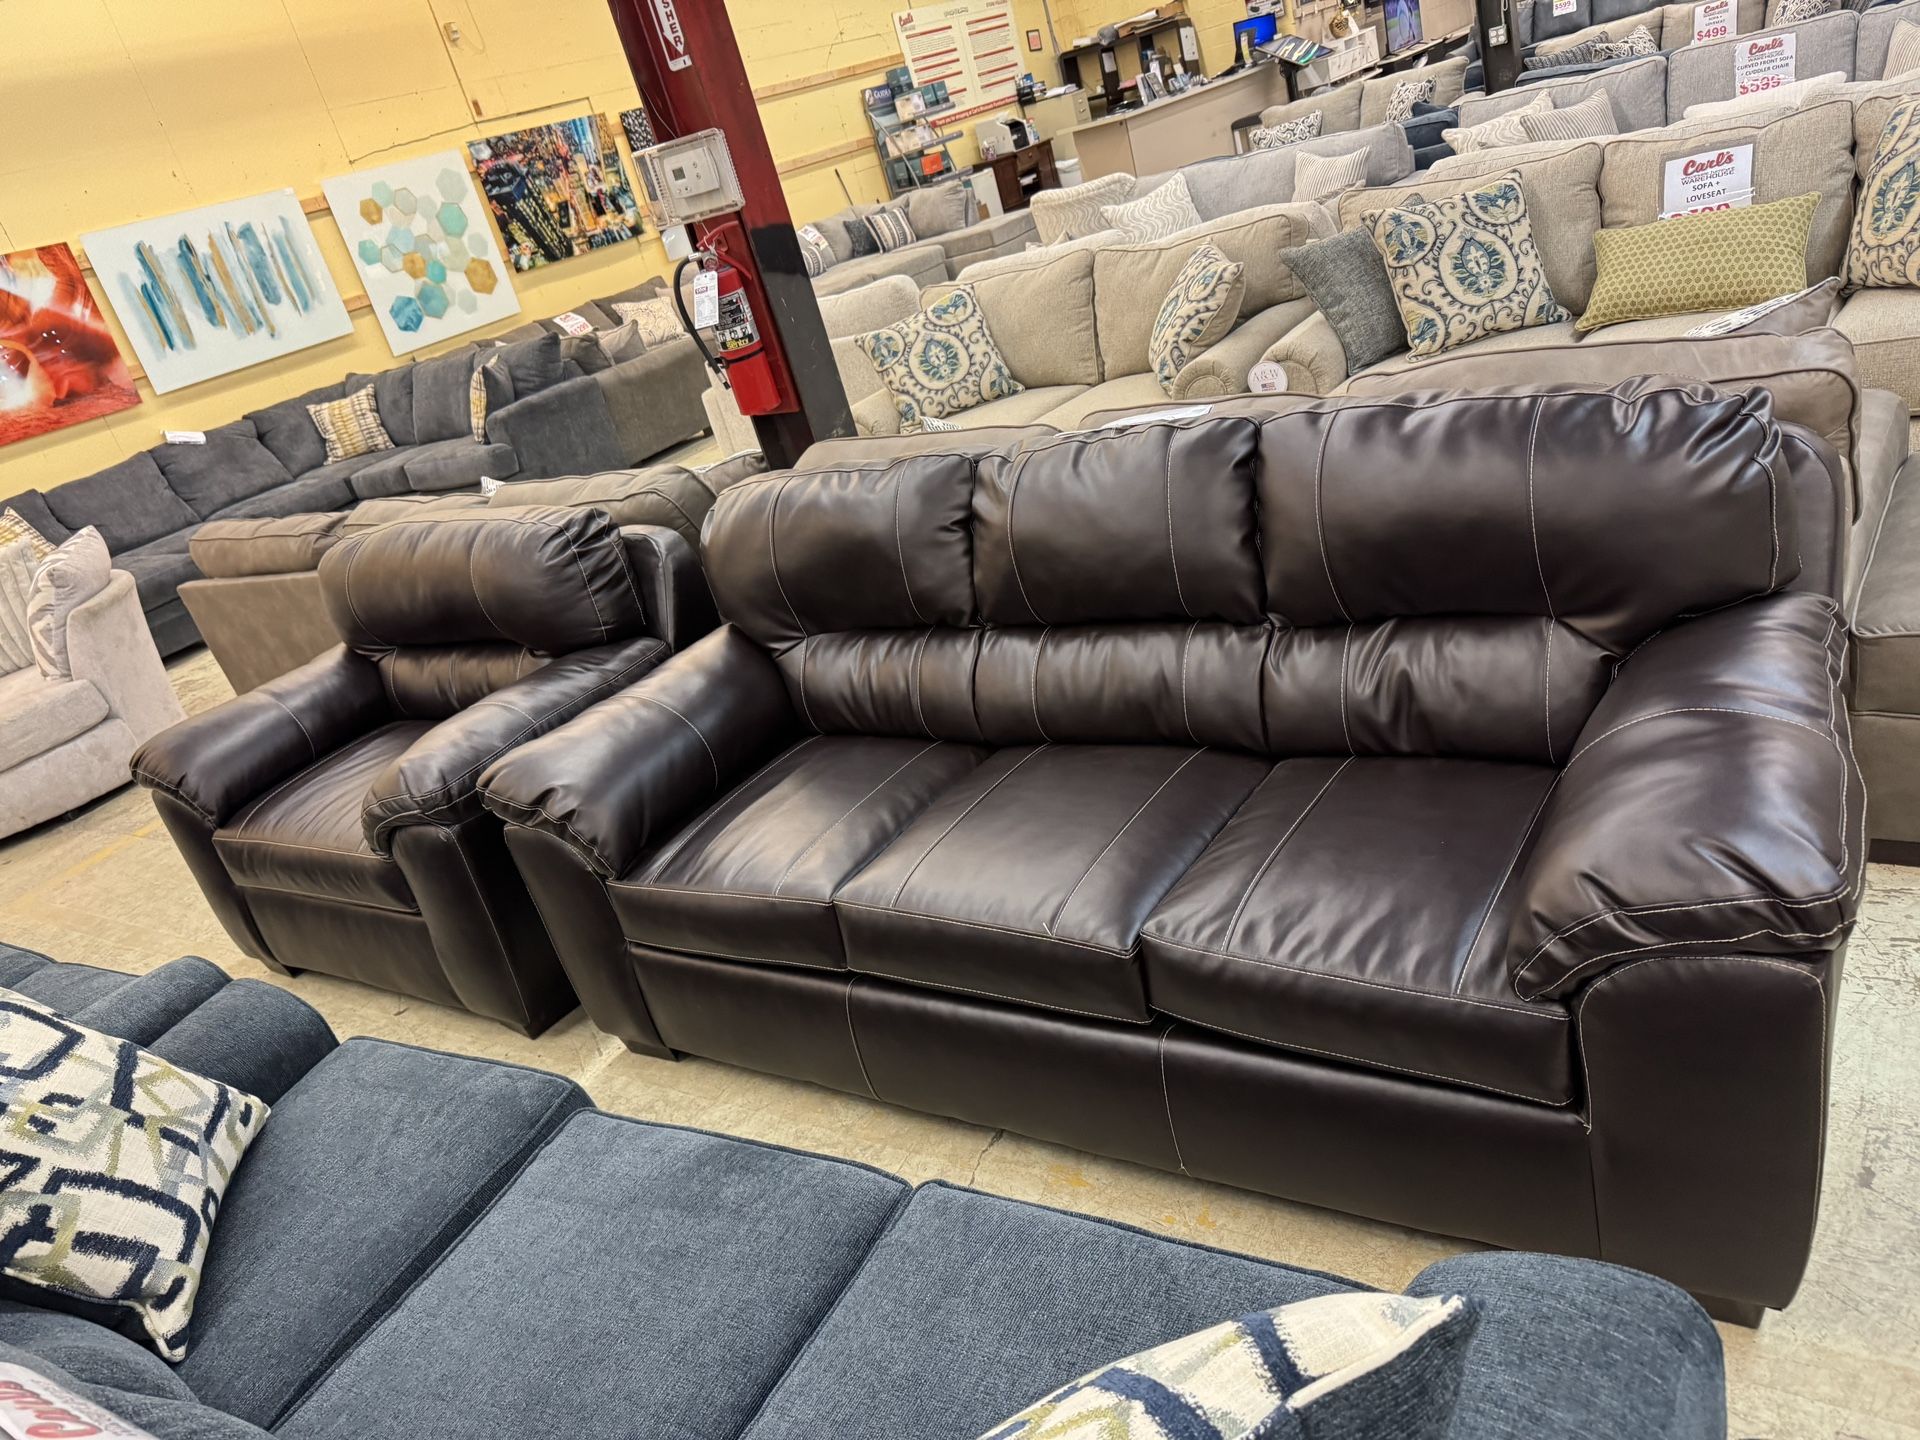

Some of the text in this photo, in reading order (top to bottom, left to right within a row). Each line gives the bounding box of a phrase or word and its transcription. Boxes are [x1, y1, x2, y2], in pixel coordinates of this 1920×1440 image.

[1704, 1, 1729, 14] Carl's
[1697, 25, 1727, 42] $499
[1749, 38, 1783, 55] Carl's
[1737, 60, 1759, 71] CURVED
[1759, 57, 1779, 66] FRONT
[1745, 66, 1771, 76] CUDDLER
[1771, 62, 1790, 70] CHAIR
[1739, 74, 1781, 95] $599
[1682, 151, 1734, 176] Carl's
[1681, 169, 1735, 186] WAREHOUSE
[1692, 181, 1714, 192] SOFA
[1686, 188, 1727, 204] LOVESEAT
